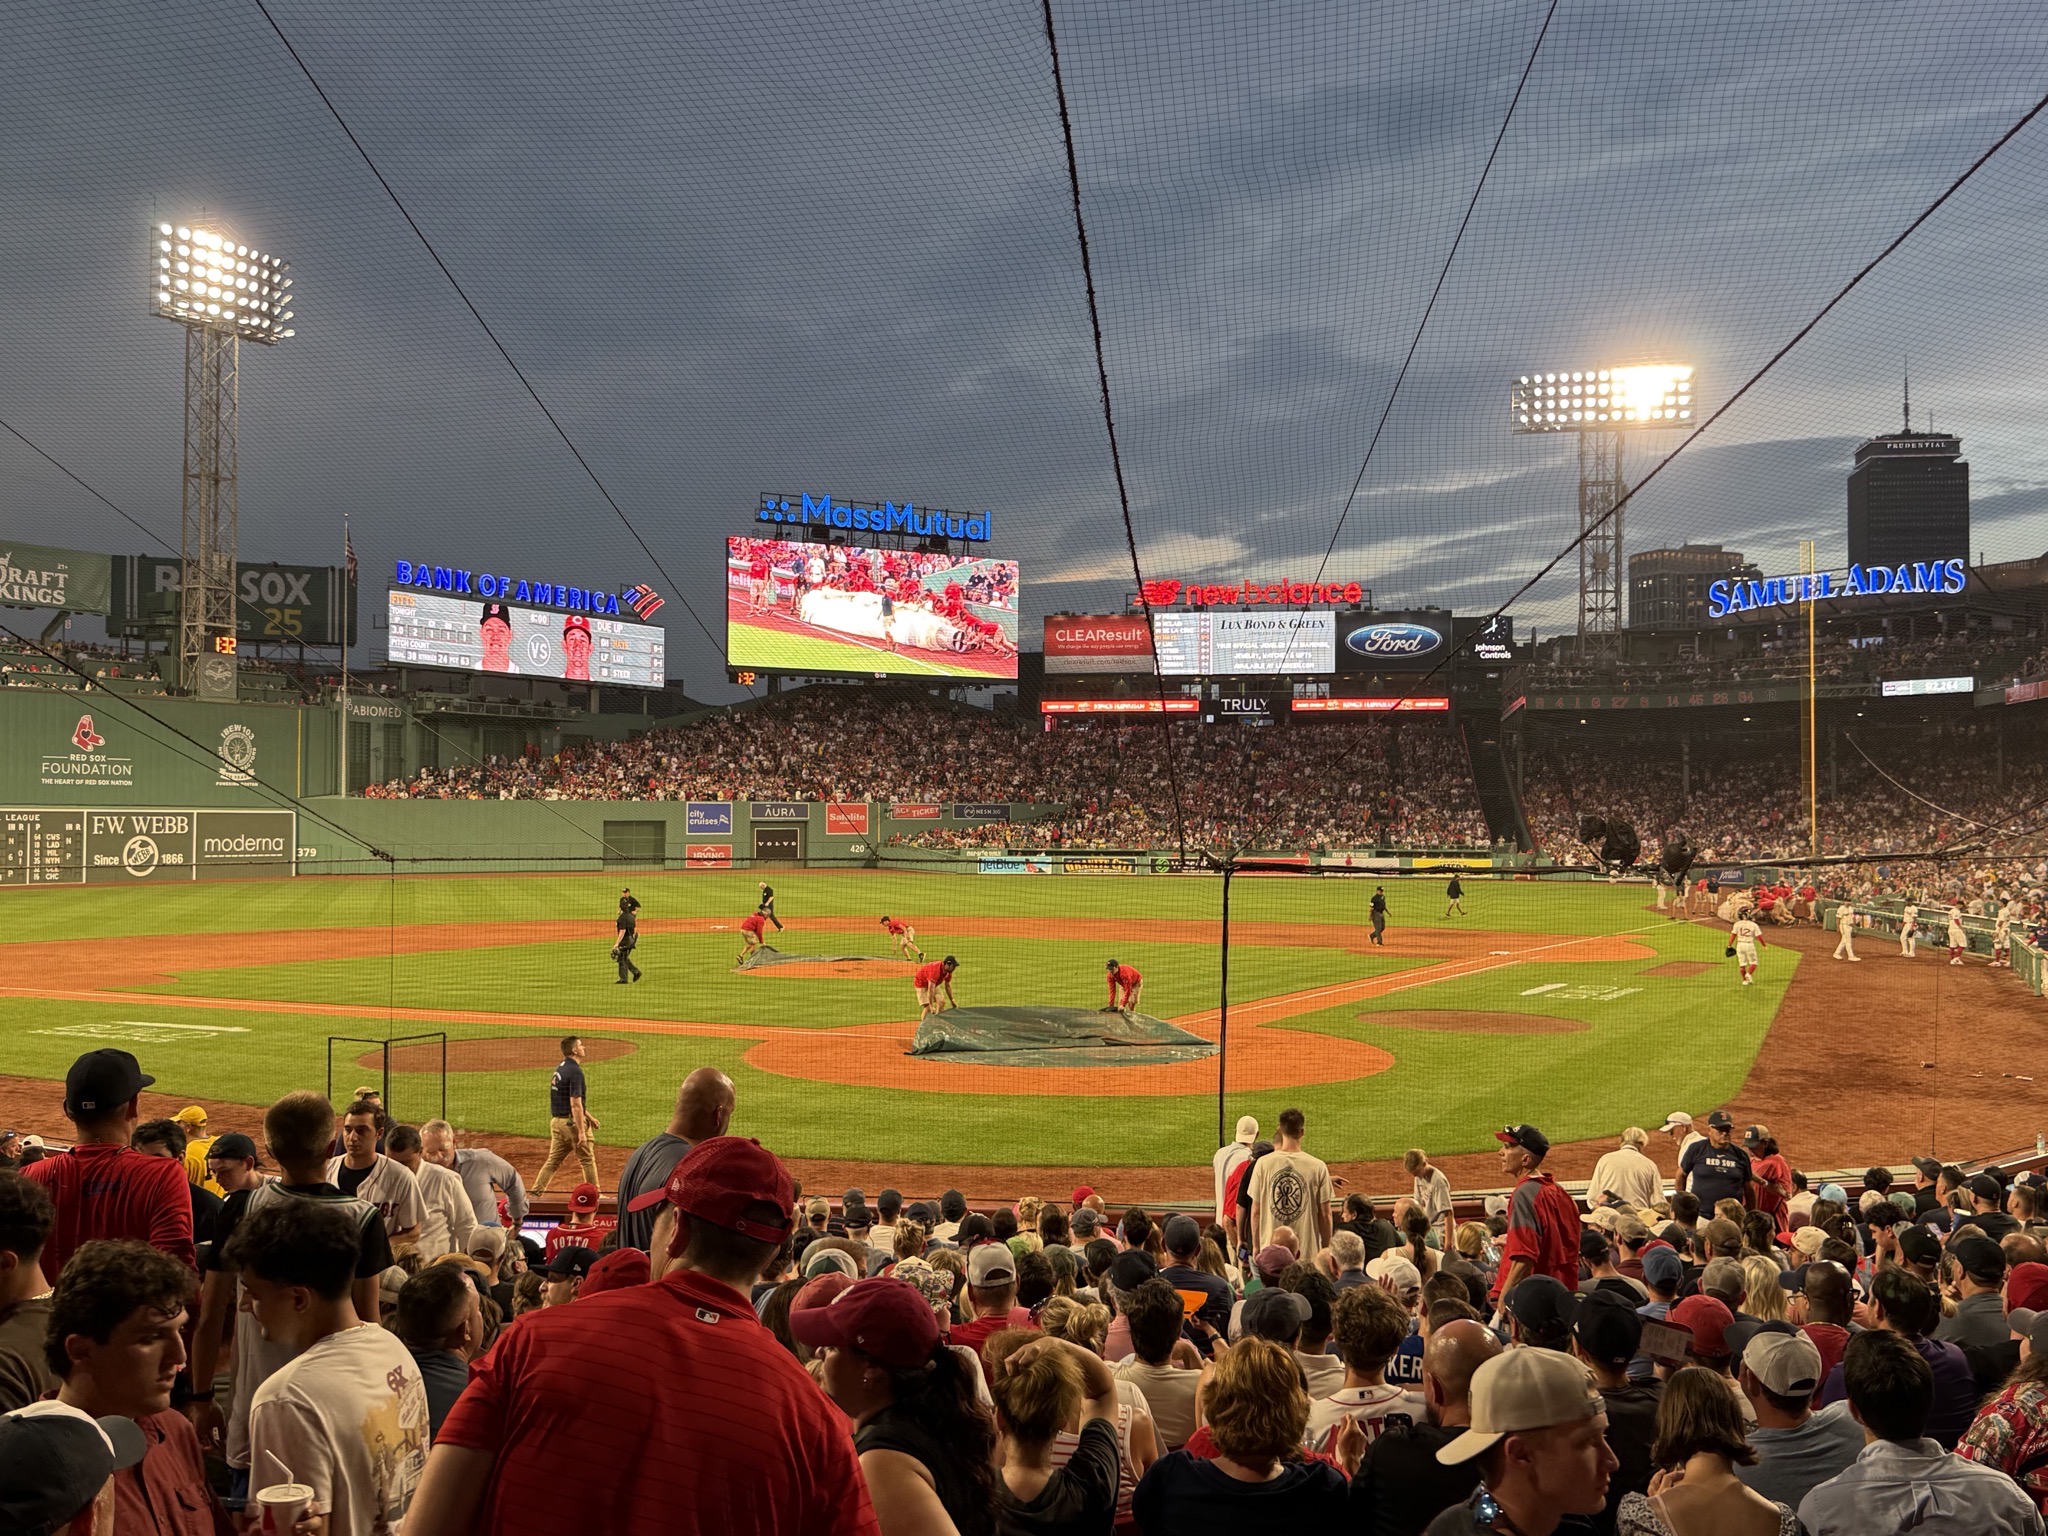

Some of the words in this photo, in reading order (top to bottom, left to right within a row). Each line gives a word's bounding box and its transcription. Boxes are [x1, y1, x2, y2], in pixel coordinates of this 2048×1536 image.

[802, 493, 992, 542] MassMutual
[241, 571, 311, 605] SOX
[396, 560, 472, 594] BANK
[478, 574, 511, 599] OF
[516, 580, 620, 616] AMERICA
[1708, 572, 1839, 618] SAMUEL
[1842, 559, 1966, 597] ADAMS
[264, 608, 302, 635] 25
[1221, 620, 1242, 630] LUX
[1244, 620, 1275, 630] BOND
[1278, 620, 1286, 629] &
[1289, 619, 1326, 629] GREEN
[391, 626, 404, 634] 3.0
[597, 622, 612, 633] DUE
[613, 623, 623, 634] UP
[1055, 628, 1142, 641] CLEAResult
[1365, 629, 1423, 652] Ford
[391, 639, 409, 647] PITCH
[410, 641, 430, 649] COUNT
[1475, 644, 1506, 652] Johnson
[531, 642, 548, 660] VS
[1480, 652, 1512, 660] Controls
[438, 655, 448, 663] 24
[1221, 699, 1268, 711] TRULY
[353, 706, 402, 718] ABIOMED
[220, 724, 241, 739] IBEW
[242, 727, 255, 740] 103
[42, 763, 132, 776] FOUNDATION
[689, 810, 704, 819] city
[912, 807, 939, 817] TICKET
[131, 816, 189, 834] WEBB
[204, 834, 284, 852] moderna
[850, 845, 865, 853] 420
[132, 849, 151, 864] WEBB
[297, 848, 317, 857] 379
[94, 855, 119, 865] Since
[161, 854, 184, 864] 1866
[1740, 928, 1751, 937] 12
[1705, 1158, 1720, 1166] RED
[552, 1236, 589, 1250] VOTTO
